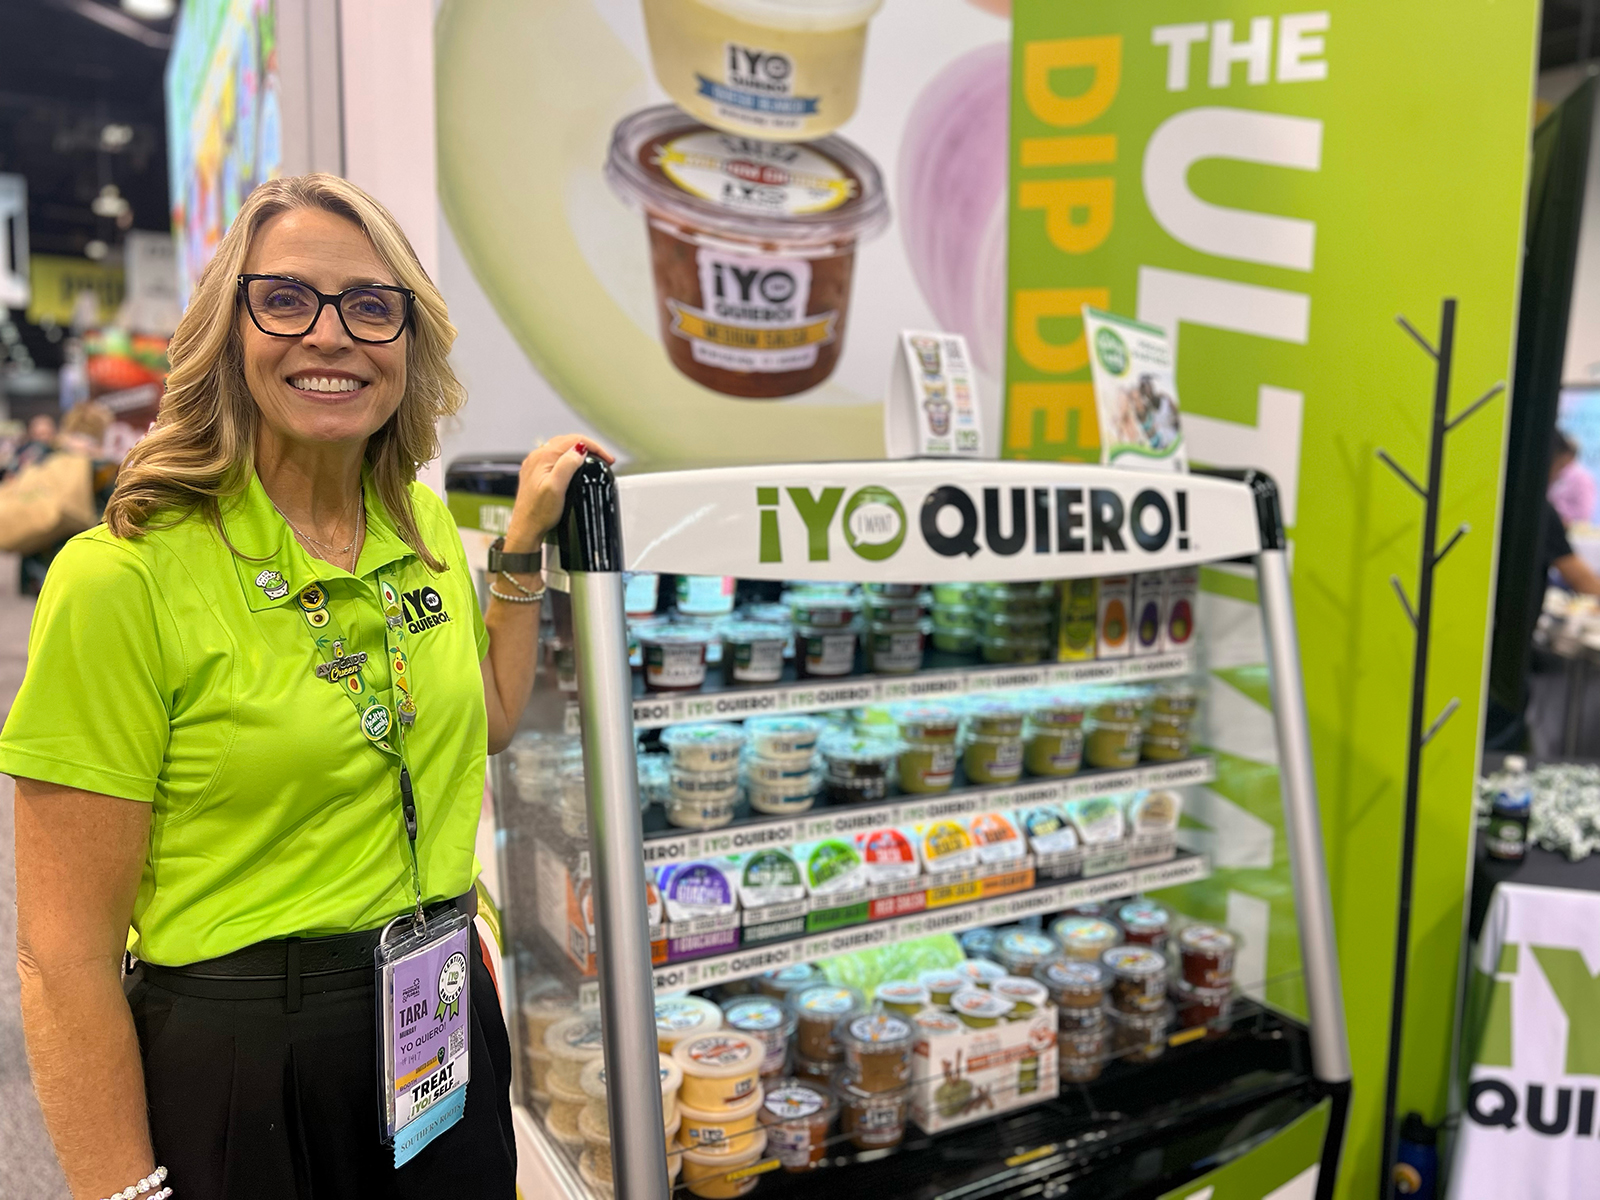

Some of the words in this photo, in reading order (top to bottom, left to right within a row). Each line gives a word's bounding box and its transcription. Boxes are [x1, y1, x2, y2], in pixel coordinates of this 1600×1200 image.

[1151, 11, 1331, 92] THE
[1017, 34, 1123, 256] DIP
[713, 262, 796, 303] ¡YO
[1007, 286, 1110, 462] DE
[757, 485, 907, 563] ¡YO
[920, 485, 1190, 559] QUIERO!
[864, 513, 892, 534] WANT
[408, 611, 451, 635] QUIERO!
[318, 652, 367, 675] AVOCADO
[330, 665, 358, 681] Queen
[716, 695, 776, 713] QUIERO!
[734, 827, 794, 847] QUIERO!
[444, 955, 465, 973] CERTIFIED
[731, 952, 791, 972] QUIERO!
[440, 986, 462, 1003] SNACKER
[399, 999, 428, 1028] TARA
[399, 1026, 417, 1040] MURRAY
[400, 1041, 414, 1054] YO
[415, 1022, 447, 1047] QUIERO!
[412, 1061, 455, 1102] TREAT
[432, 1078, 455, 1101] SELF
[1467, 1079, 1600, 1137] QUI
[401, 1120, 439, 1153] SOUTHERN
[439, 1103, 461, 1123] ROOTS
